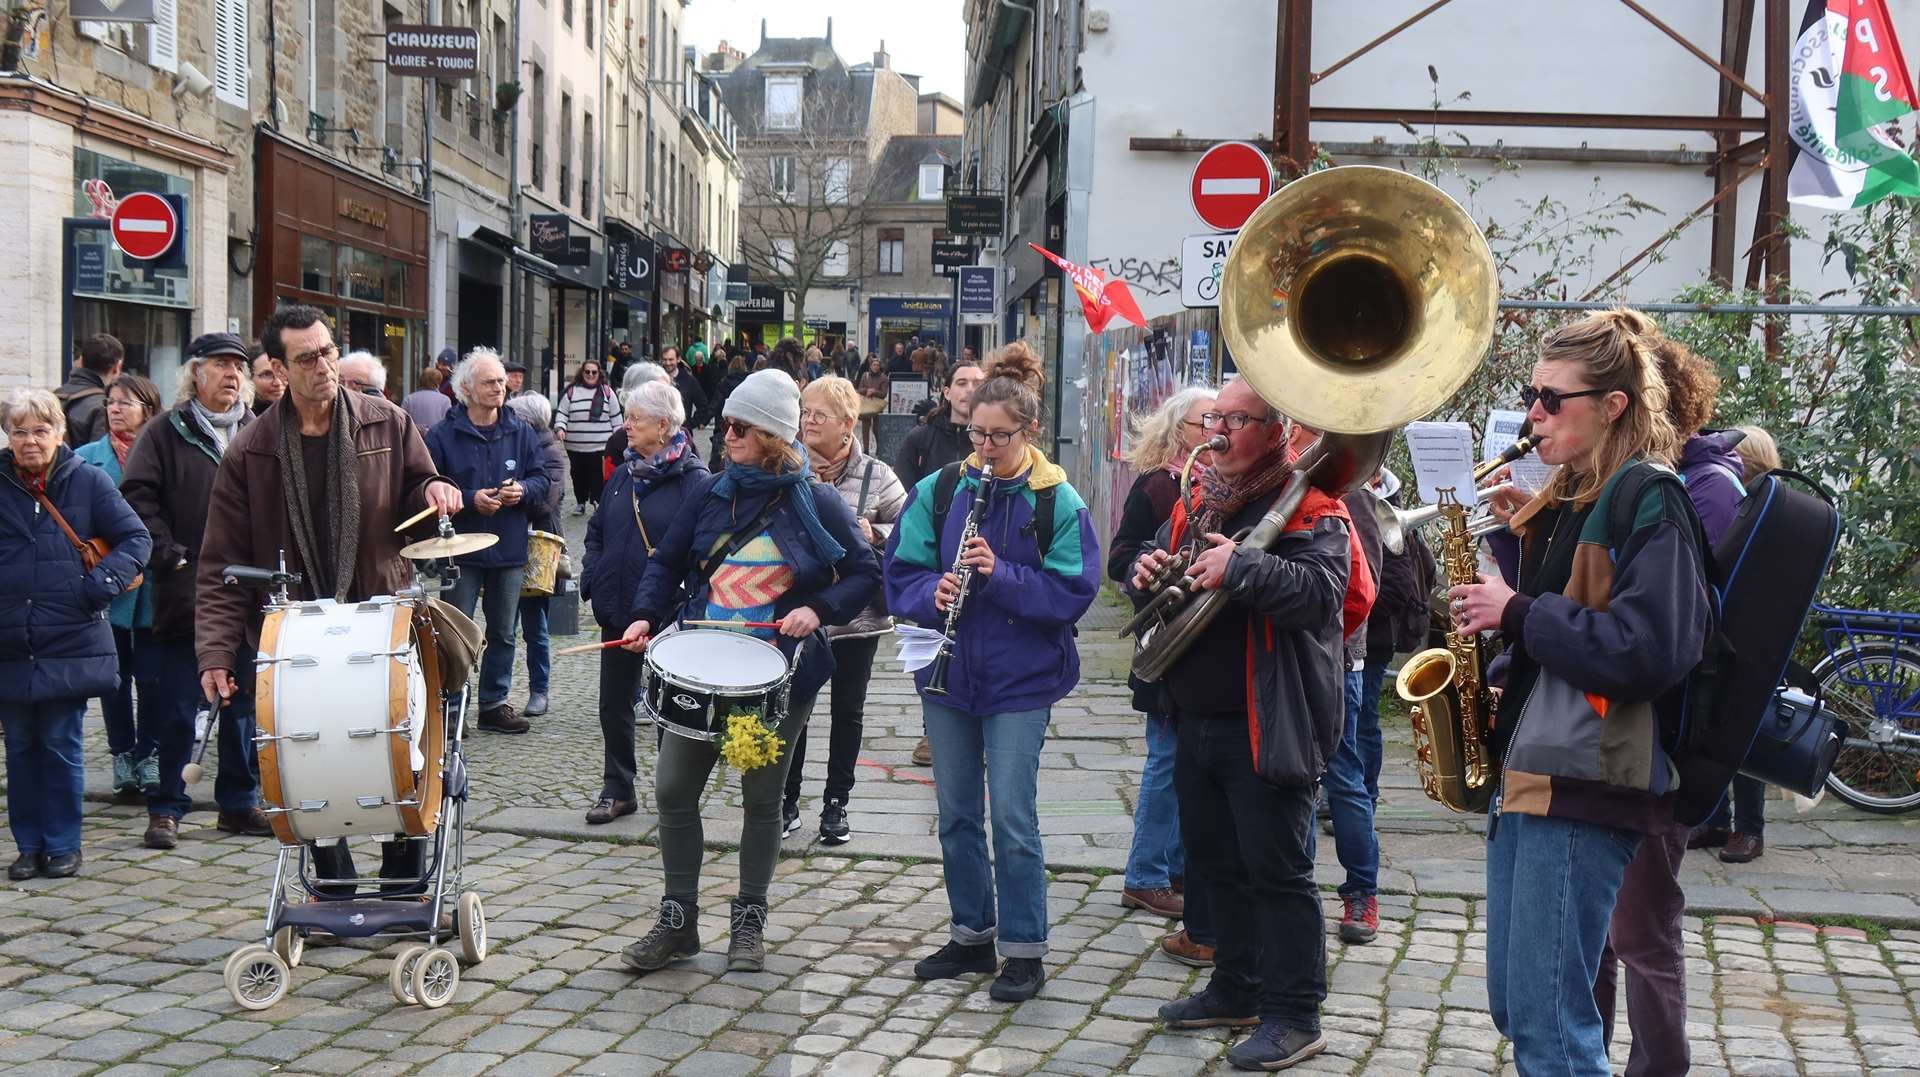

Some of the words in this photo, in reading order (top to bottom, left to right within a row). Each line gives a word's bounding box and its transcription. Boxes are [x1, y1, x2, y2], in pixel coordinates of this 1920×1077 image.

[387, 32, 476, 49] CHAUSSEUR
[388, 53, 428, 68] LAGREE
[436, 56, 474, 69] TOUDIC
[619, 243, 628, 289] DESSANGE
